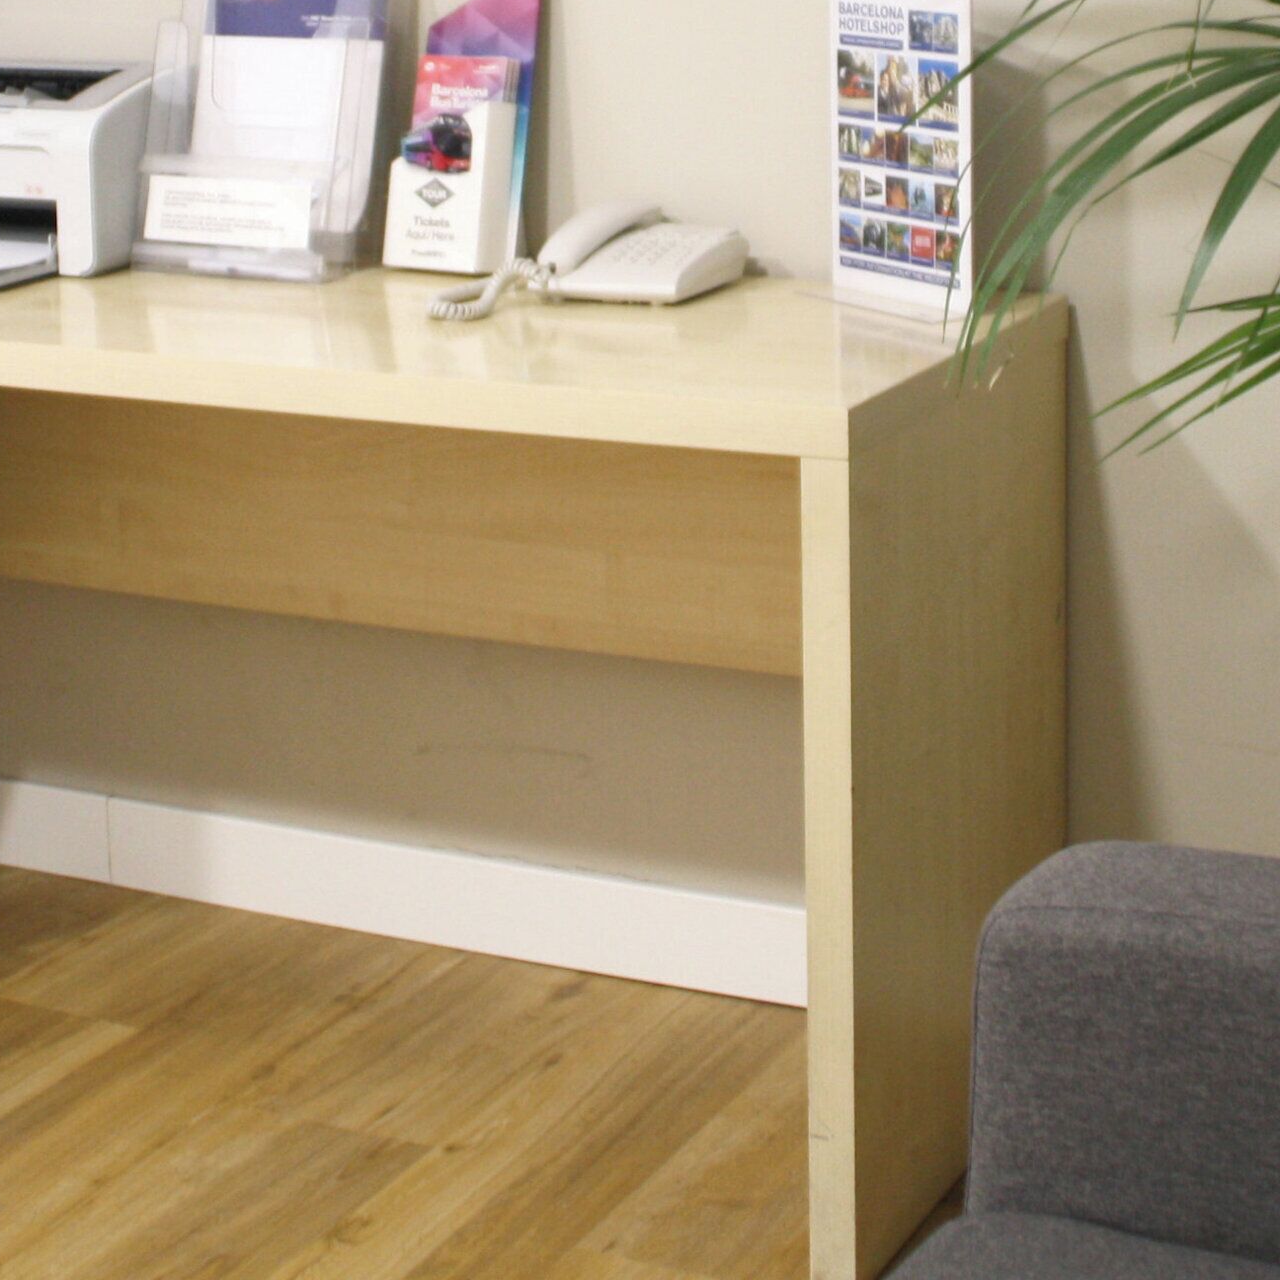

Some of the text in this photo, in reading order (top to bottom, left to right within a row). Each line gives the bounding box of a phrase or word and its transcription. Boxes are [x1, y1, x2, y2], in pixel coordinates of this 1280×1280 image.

[838, 0, 904, 20] BARCELONA
[838, 17, 905, 36] HOTELSHOP
[431, 82, 489, 98] Barcelona
[422, 188, 448, 201] TOUR
[413, 215, 451, 228] Tickets
